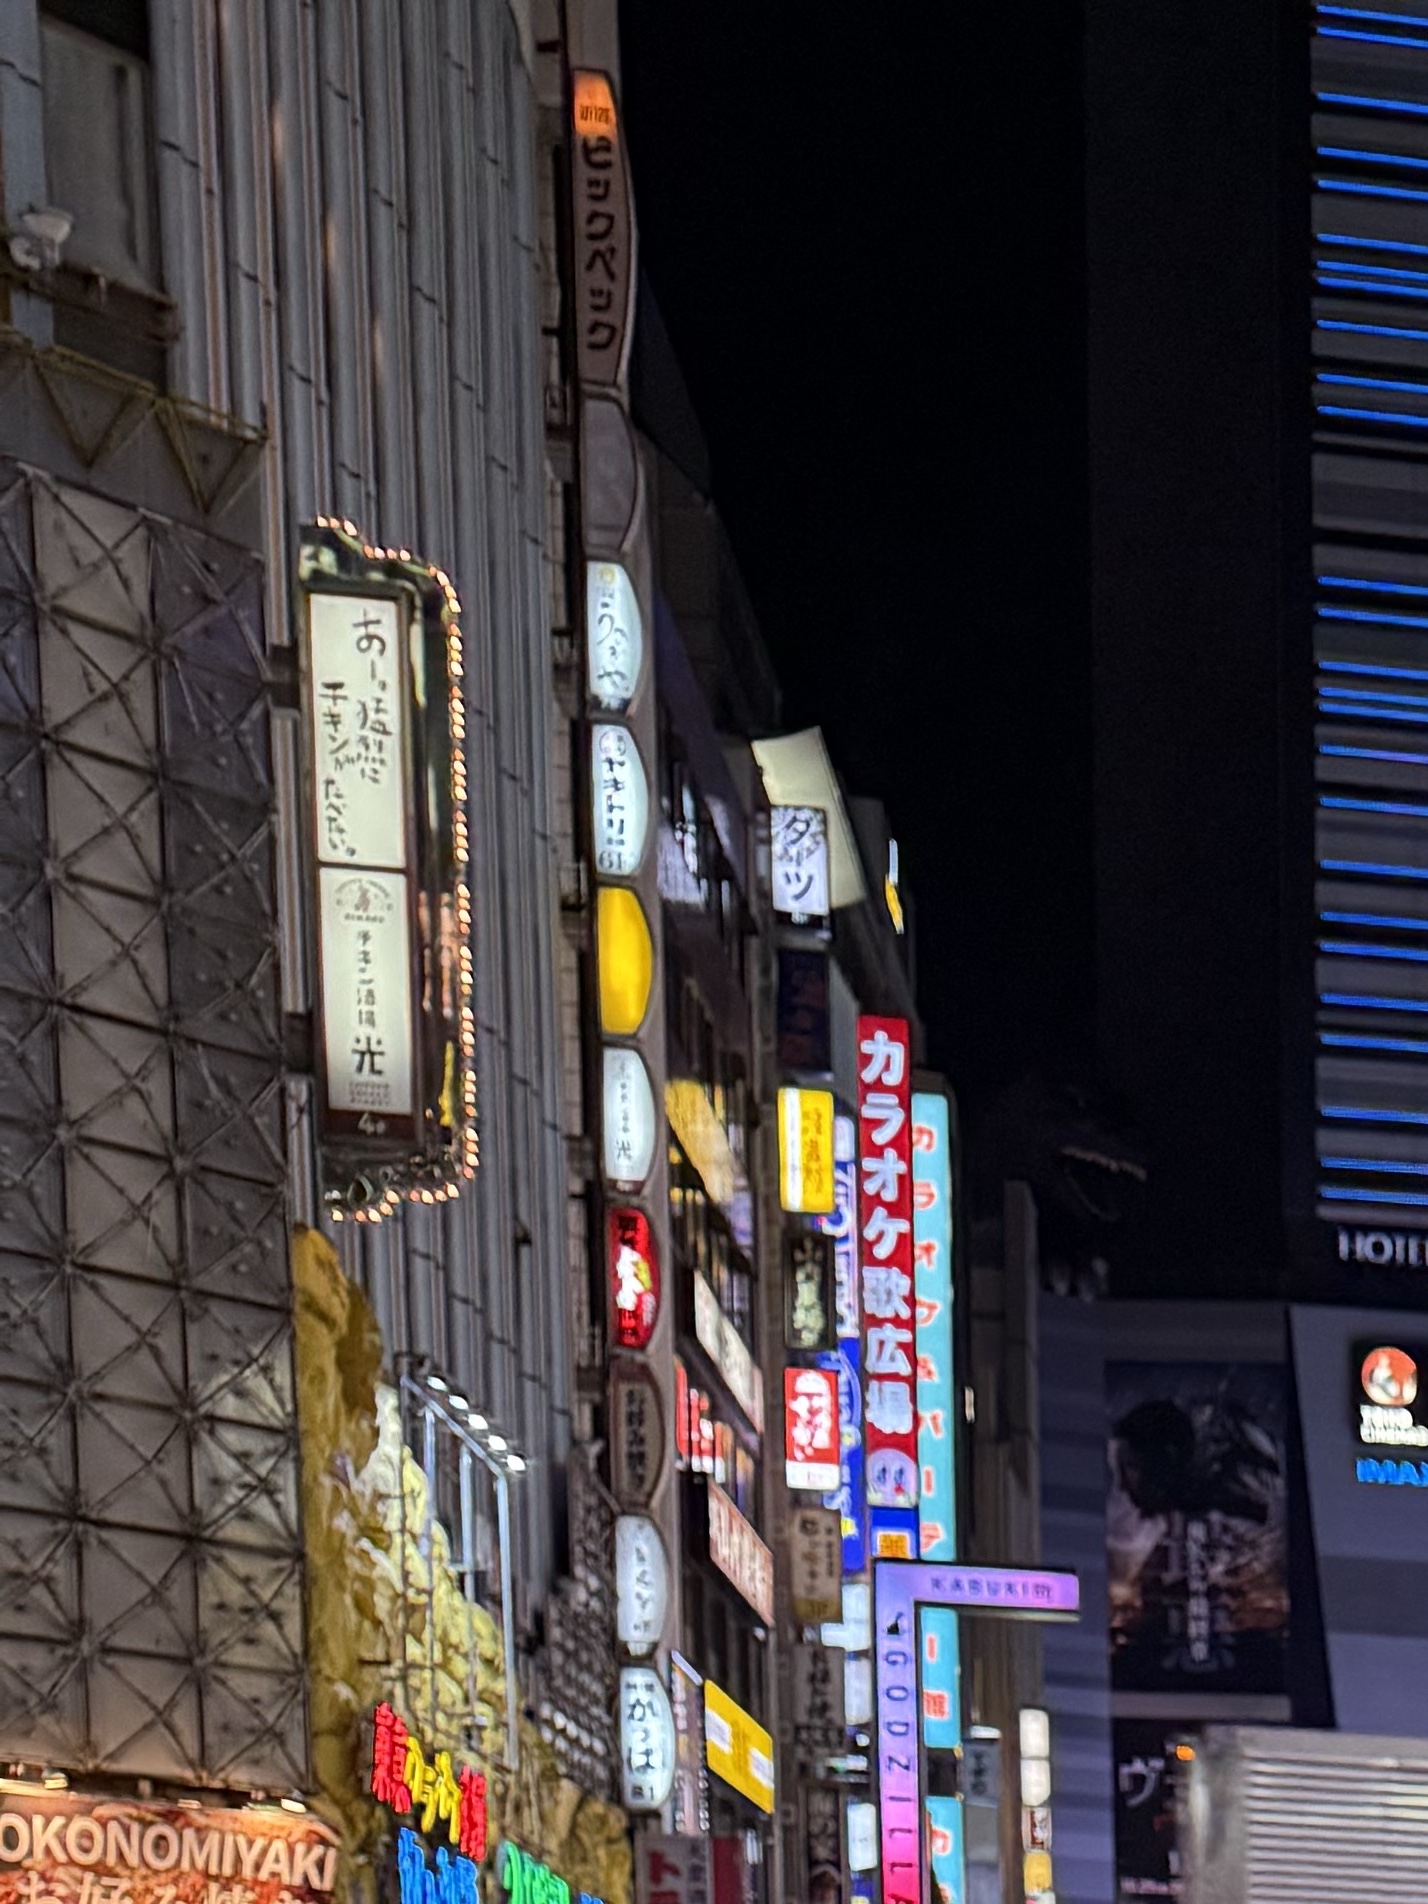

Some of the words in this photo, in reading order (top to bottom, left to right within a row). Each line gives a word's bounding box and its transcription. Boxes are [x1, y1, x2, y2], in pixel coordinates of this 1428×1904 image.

[860, 1029, 914, 1435] カラオケ歌広場
[0, 1812, 337, 1892] OKONOMIYAKI
